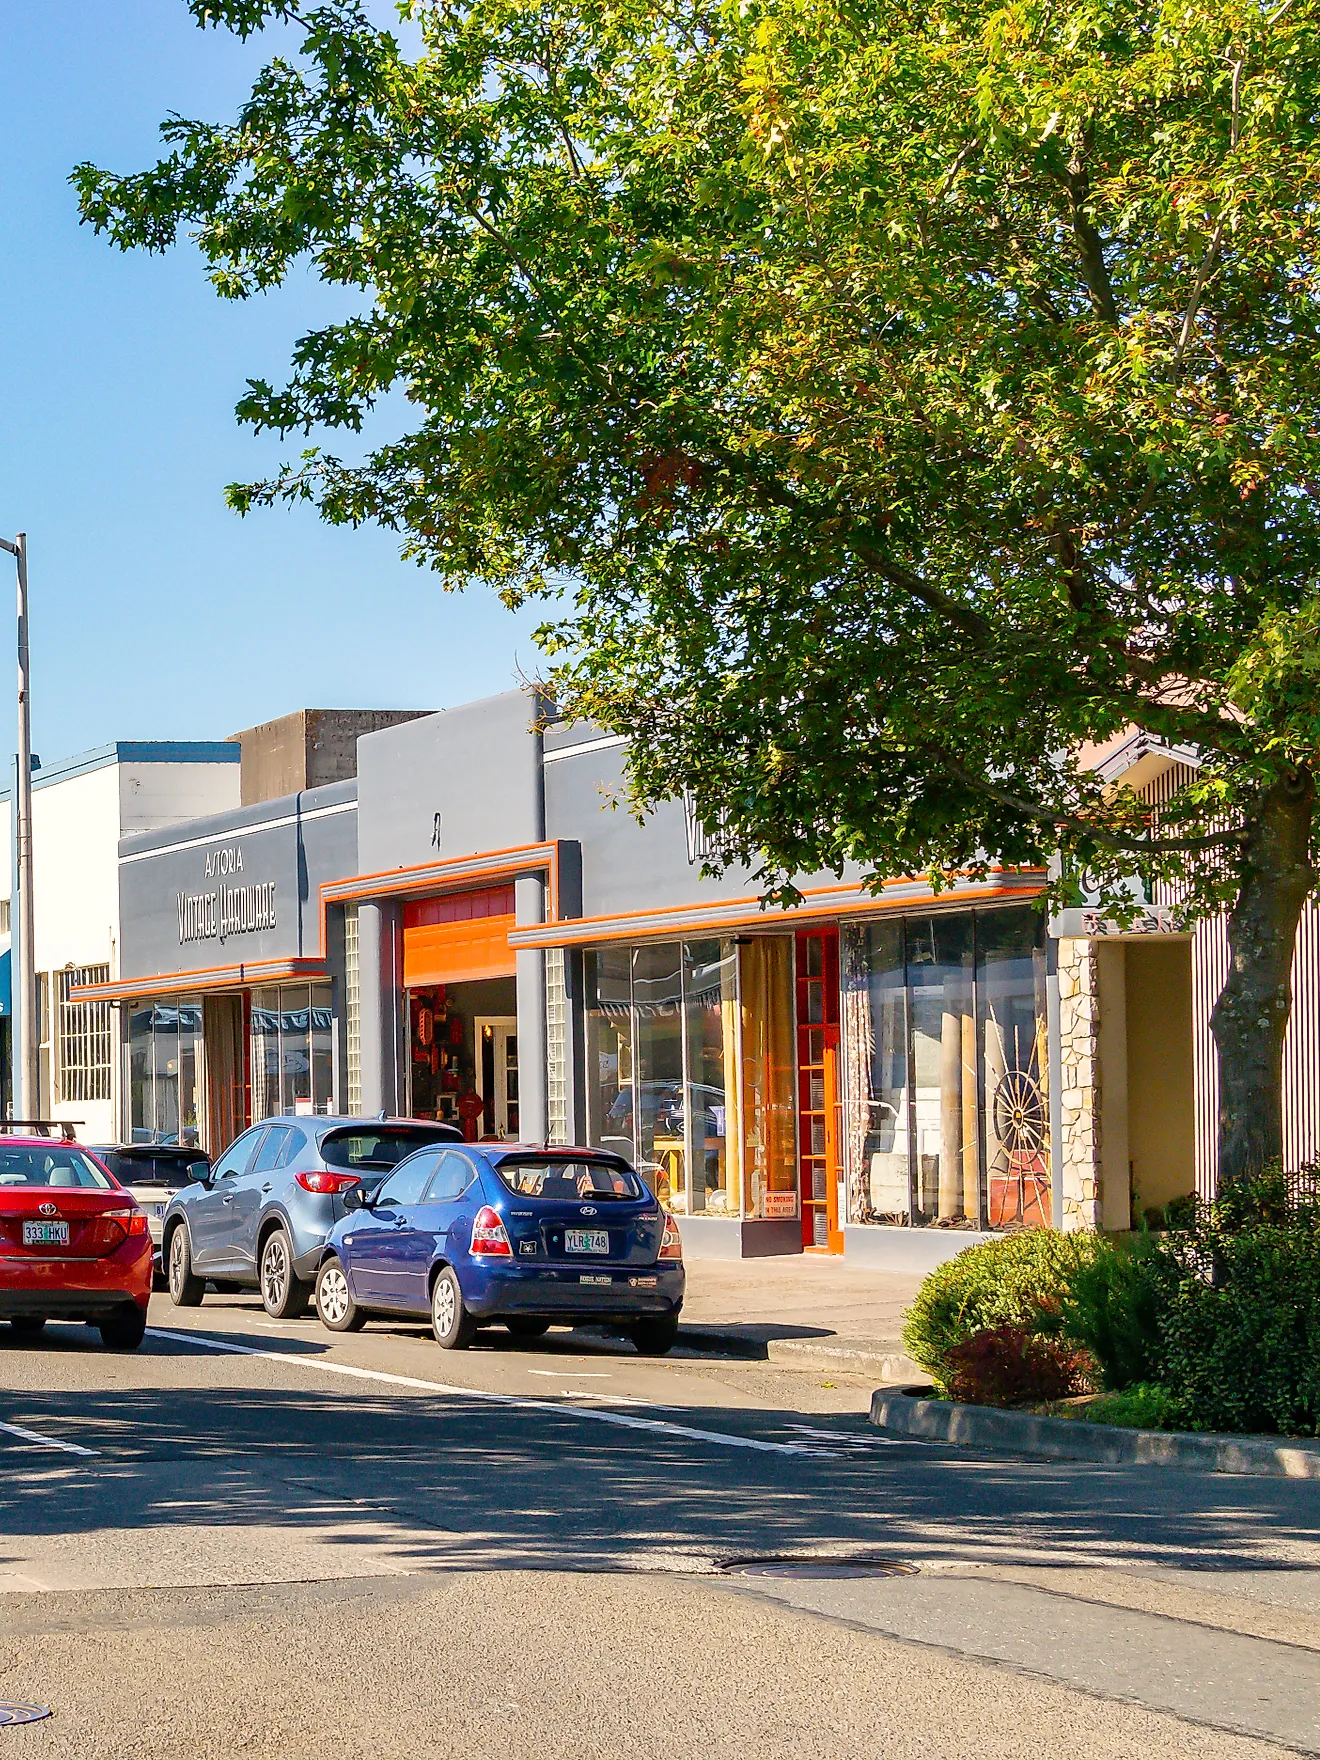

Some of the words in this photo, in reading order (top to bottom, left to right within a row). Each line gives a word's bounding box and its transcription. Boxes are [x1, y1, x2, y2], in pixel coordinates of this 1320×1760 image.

[204, 846, 244, 878] ASTORIA
[176, 891, 217, 945] VINTAGE
[219, 881, 276, 940] HARDWARE
[26, 1227, 43, 1239] 333
[48, 1227, 67, 1239] HKU
[568, 1235, 584, 1248] YLR
[590, 1235, 606, 1248] 748
